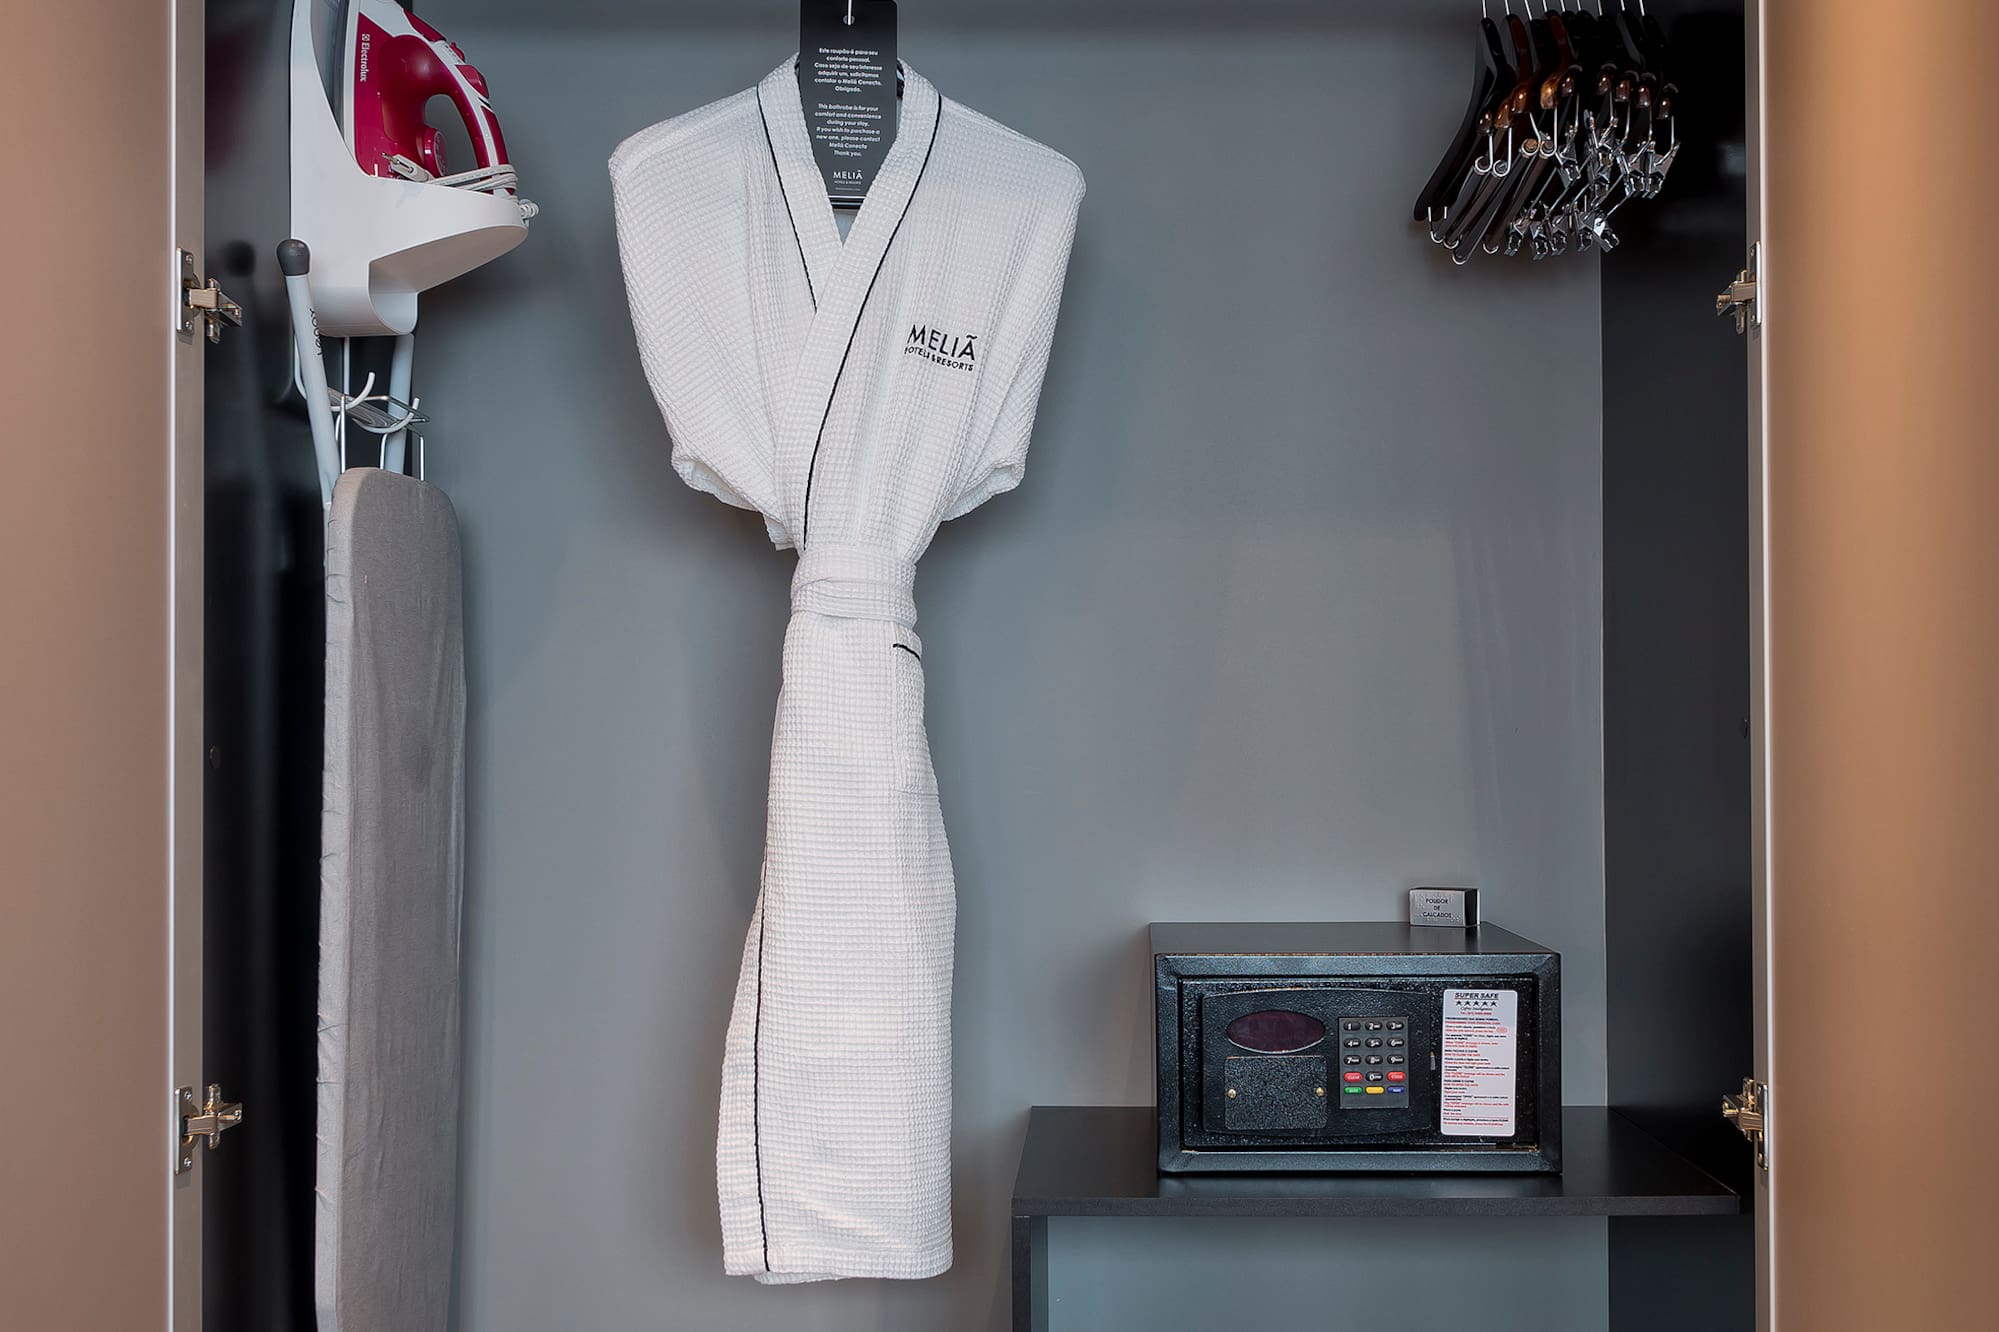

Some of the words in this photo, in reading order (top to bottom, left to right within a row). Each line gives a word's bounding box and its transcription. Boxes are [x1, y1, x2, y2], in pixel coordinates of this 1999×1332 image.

[360, 42, 370, 82] Electrolux
[907, 324, 978, 361] MELIÃ
[936, 356, 974, 372] RESORTS
